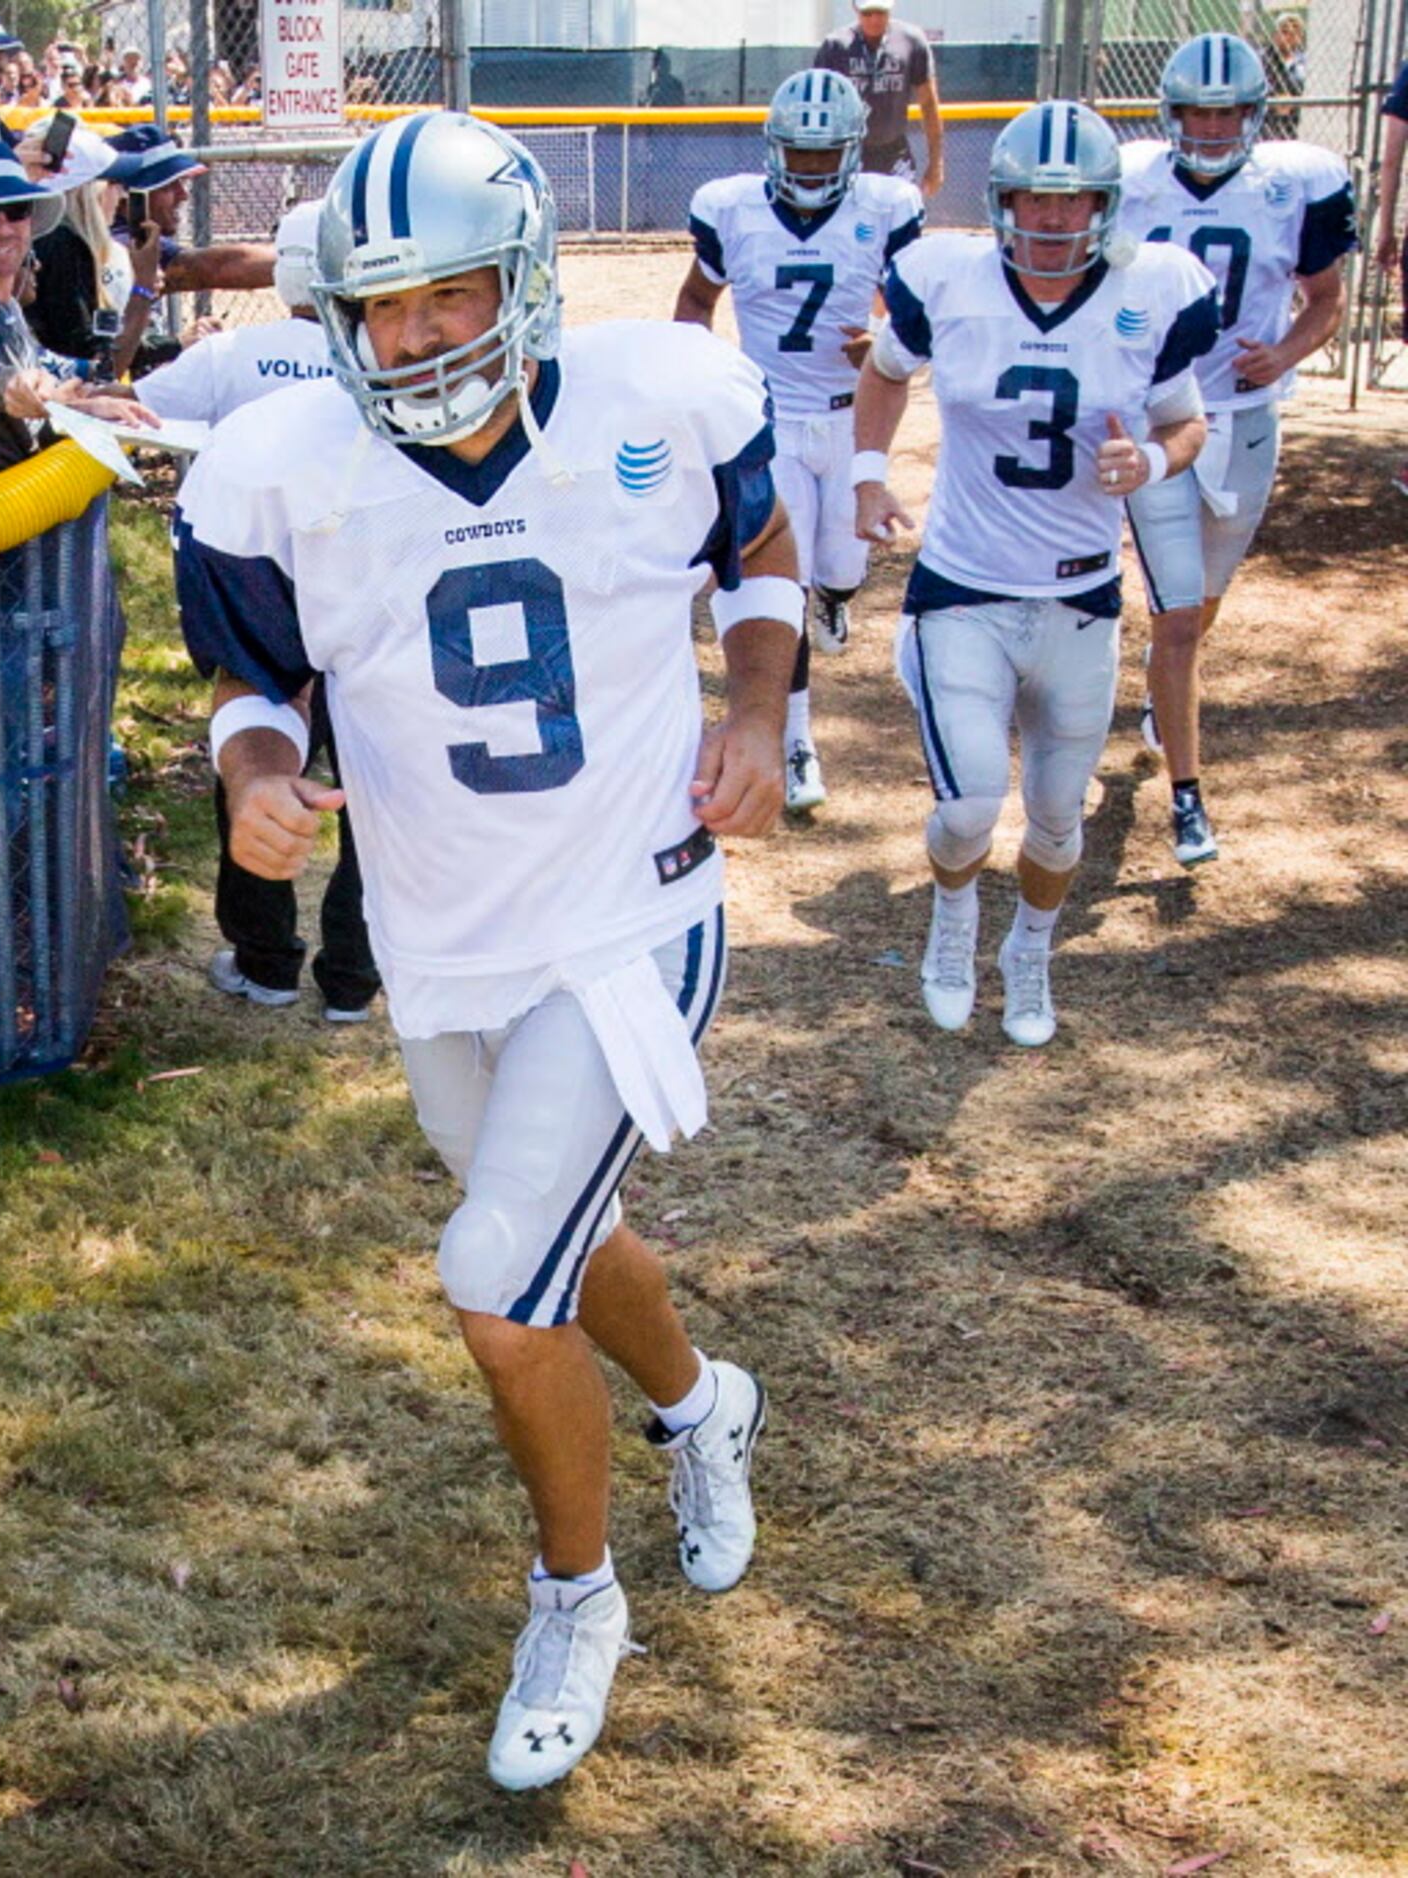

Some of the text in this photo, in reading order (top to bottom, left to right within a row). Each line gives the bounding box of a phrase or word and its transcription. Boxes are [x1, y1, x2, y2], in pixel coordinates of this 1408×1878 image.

[278, 15, 325, 42] BLOCK
[286, 52, 319, 78] GATE
[269, 88, 338, 115] ENTRANCE
[1145, 225, 1251, 332] 0
[775, 264, 834, 352] 7
[257, 359, 334, 379] VOLU
[994, 364, 1079, 490] 3
[444, 518, 527, 545] COWBOYS
[425, 557, 586, 795] 9
